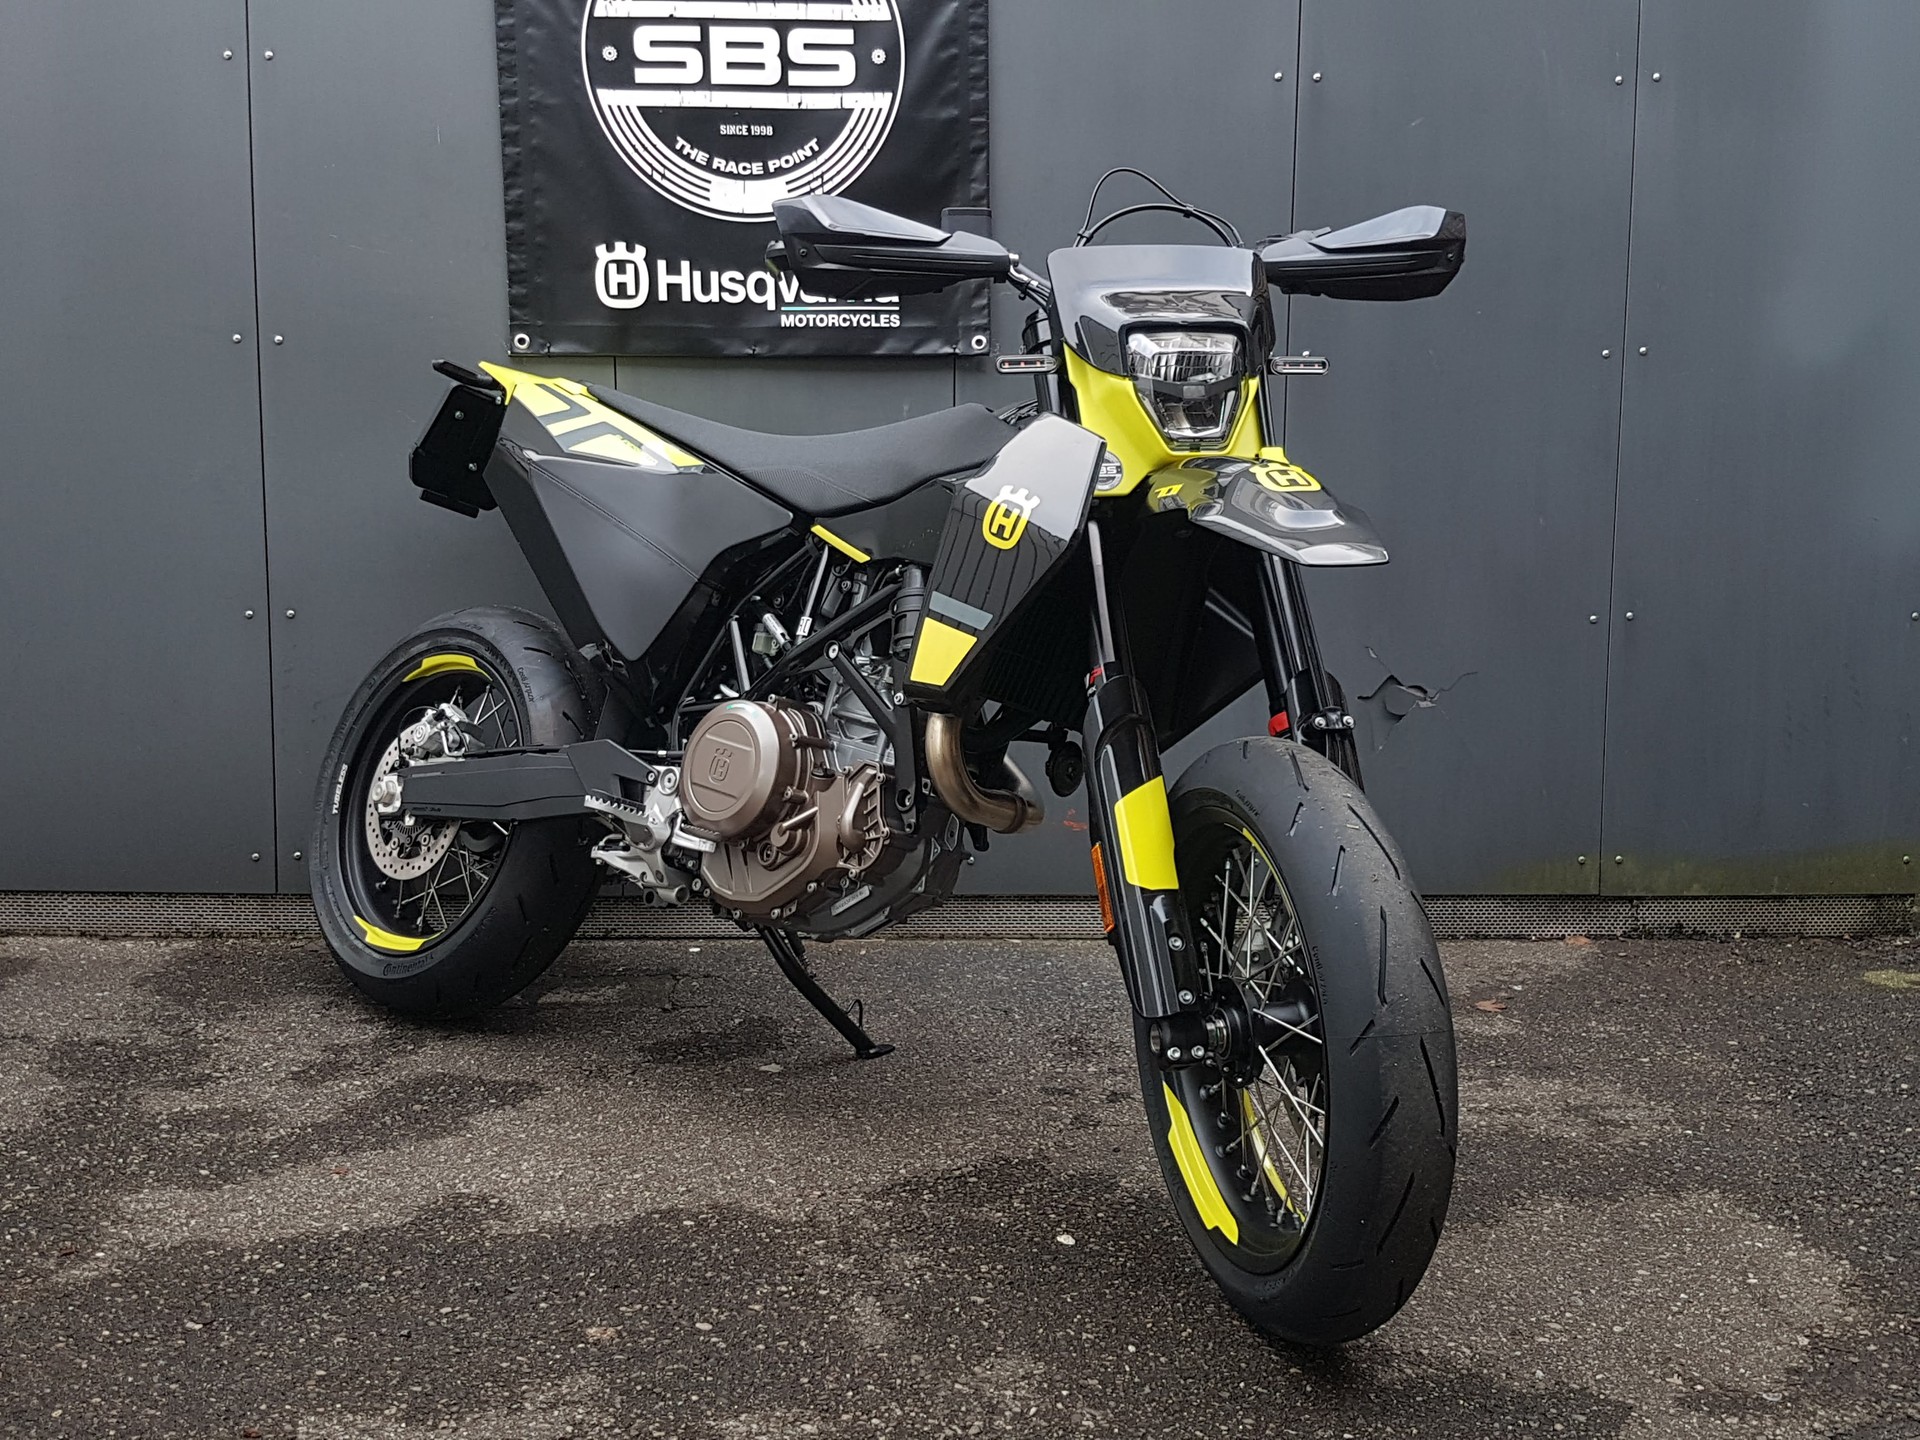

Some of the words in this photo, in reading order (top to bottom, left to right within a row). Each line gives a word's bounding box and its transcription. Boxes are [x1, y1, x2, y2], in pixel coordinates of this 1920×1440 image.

[633, 25, 857, 87] SBS
[719, 124, 749, 136] SINCE
[750, 125, 774, 136] 1998
[674, 135, 710, 166] THE
[712, 157, 764, 175] RACE
[767, 137, 820, 173] POINT
[656, 259, 899, 311] Husqv
[780, 314, 901, 328] MOTORCYCLES
[331, 763, 349, 815] TUBELESS
